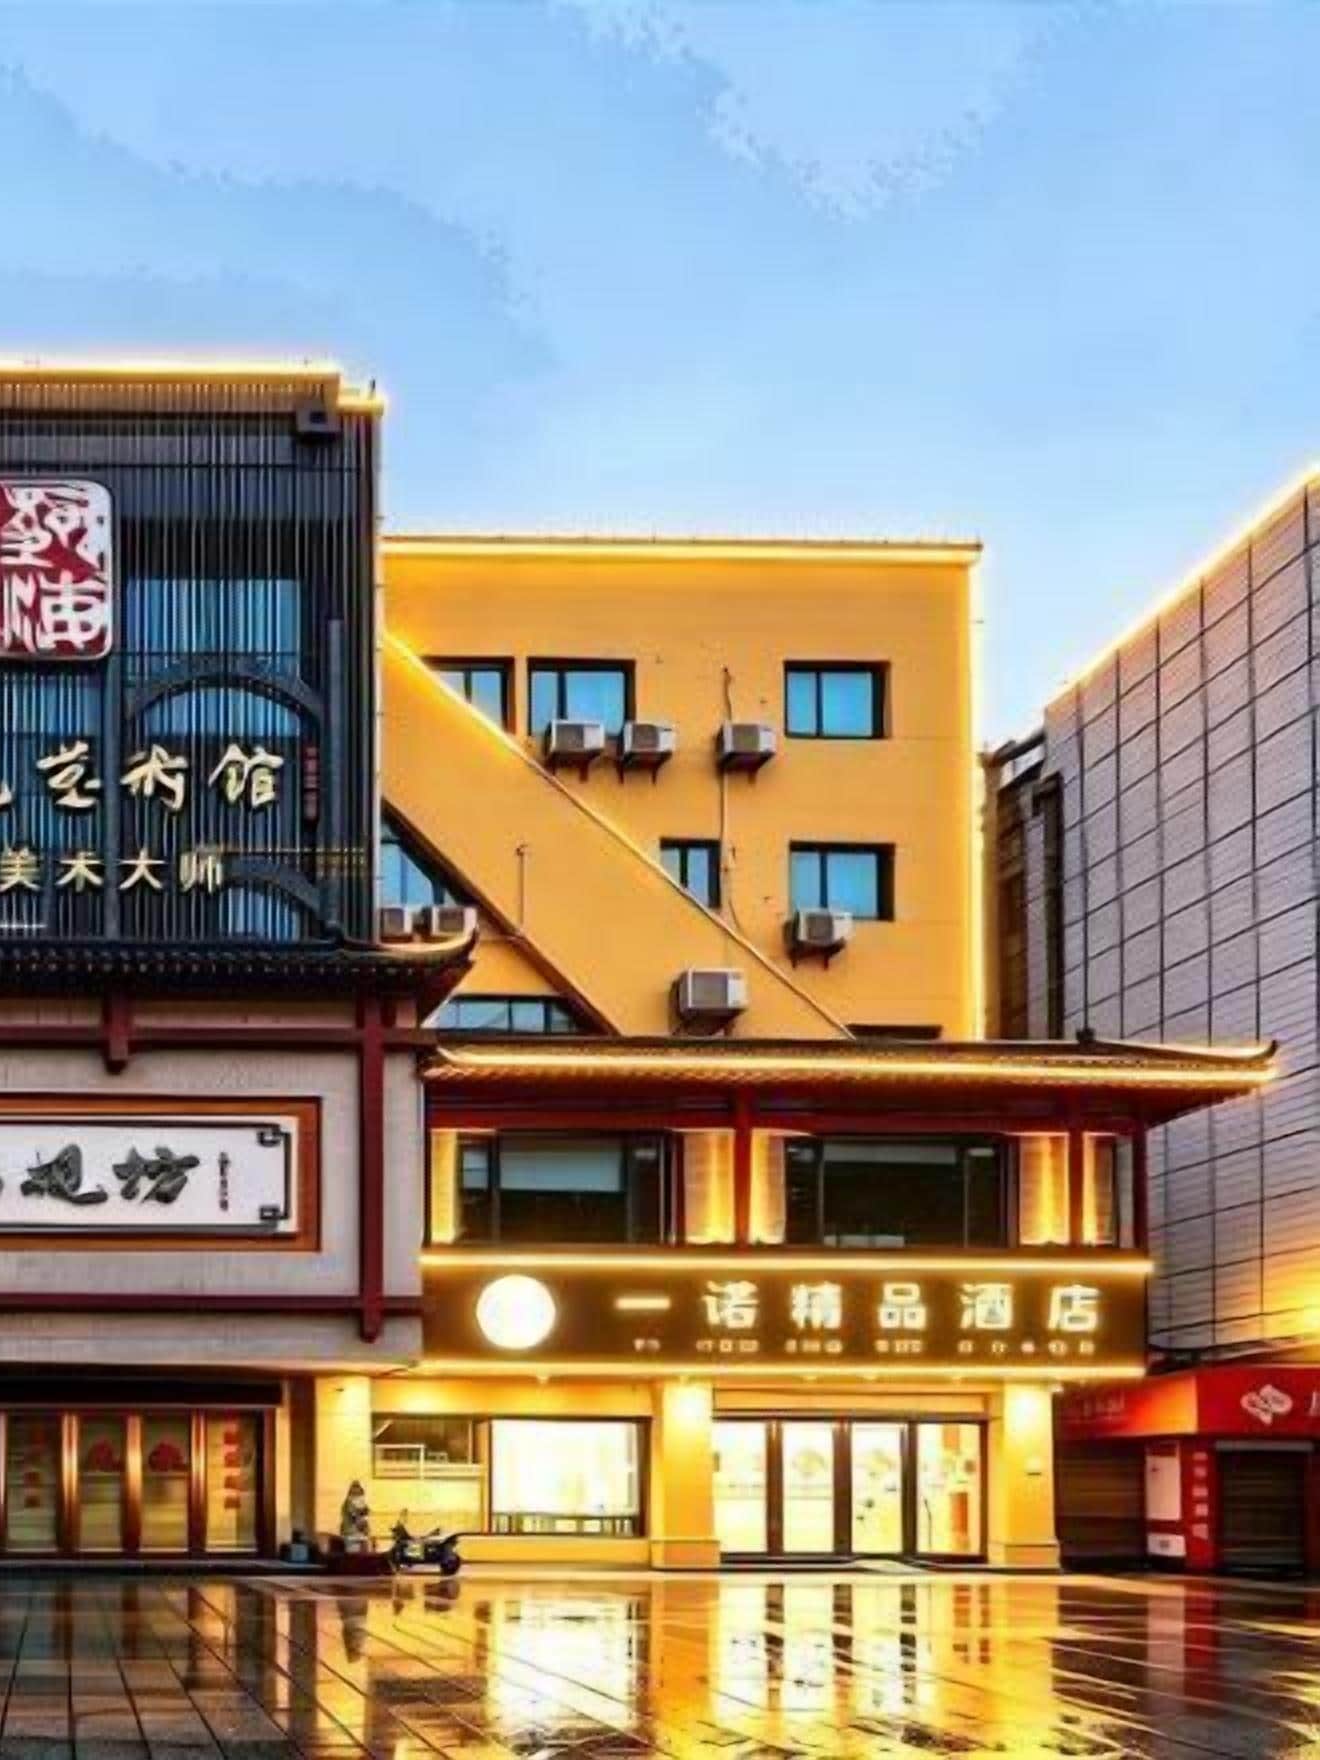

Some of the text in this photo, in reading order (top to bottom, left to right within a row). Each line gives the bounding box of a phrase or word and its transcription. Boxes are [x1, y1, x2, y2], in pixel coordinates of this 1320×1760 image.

[614, 1280, 1102, 1333] 一诺精品酒店
